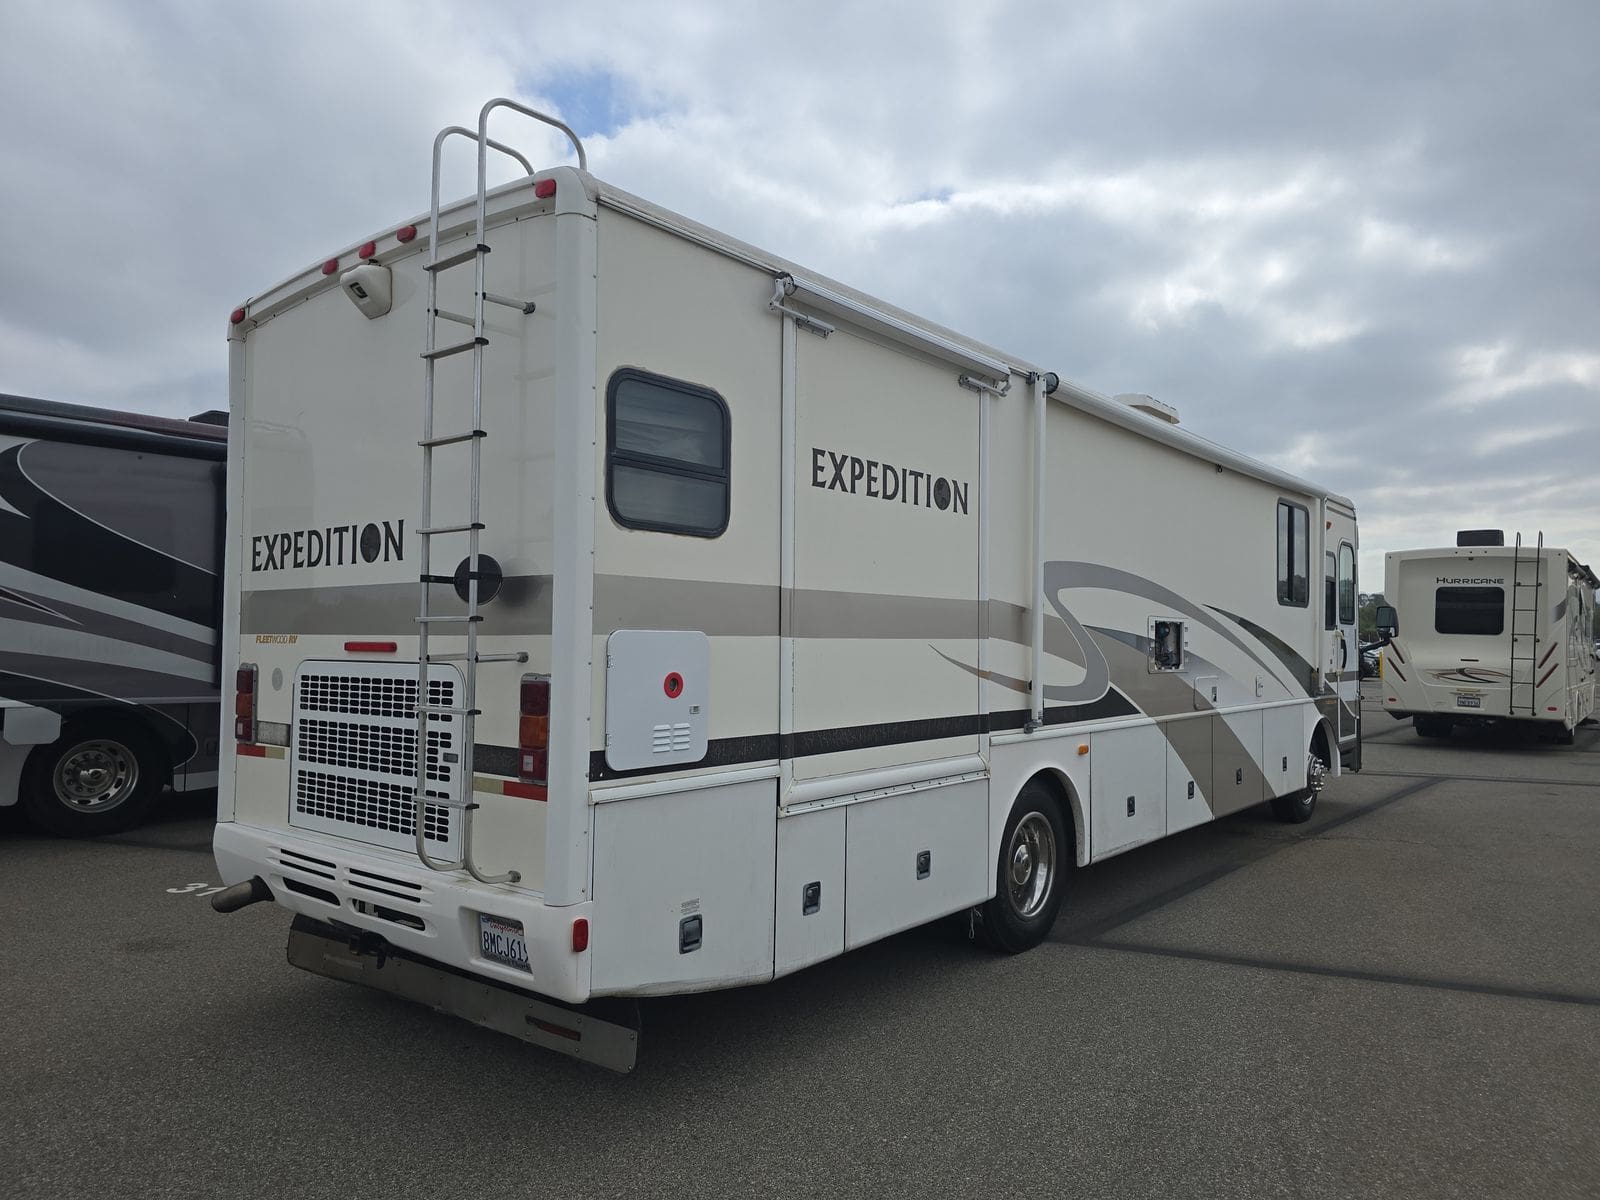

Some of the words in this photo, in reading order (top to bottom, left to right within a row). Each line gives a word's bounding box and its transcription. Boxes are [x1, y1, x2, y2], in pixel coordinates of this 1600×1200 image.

[811, 447, 969, 515] EXPEDITION
[251, 519, 405, 572] EXPEDITION
[1436, 577, 1505, 585] HURRICANE
[288, 635, 298, 644] RV
